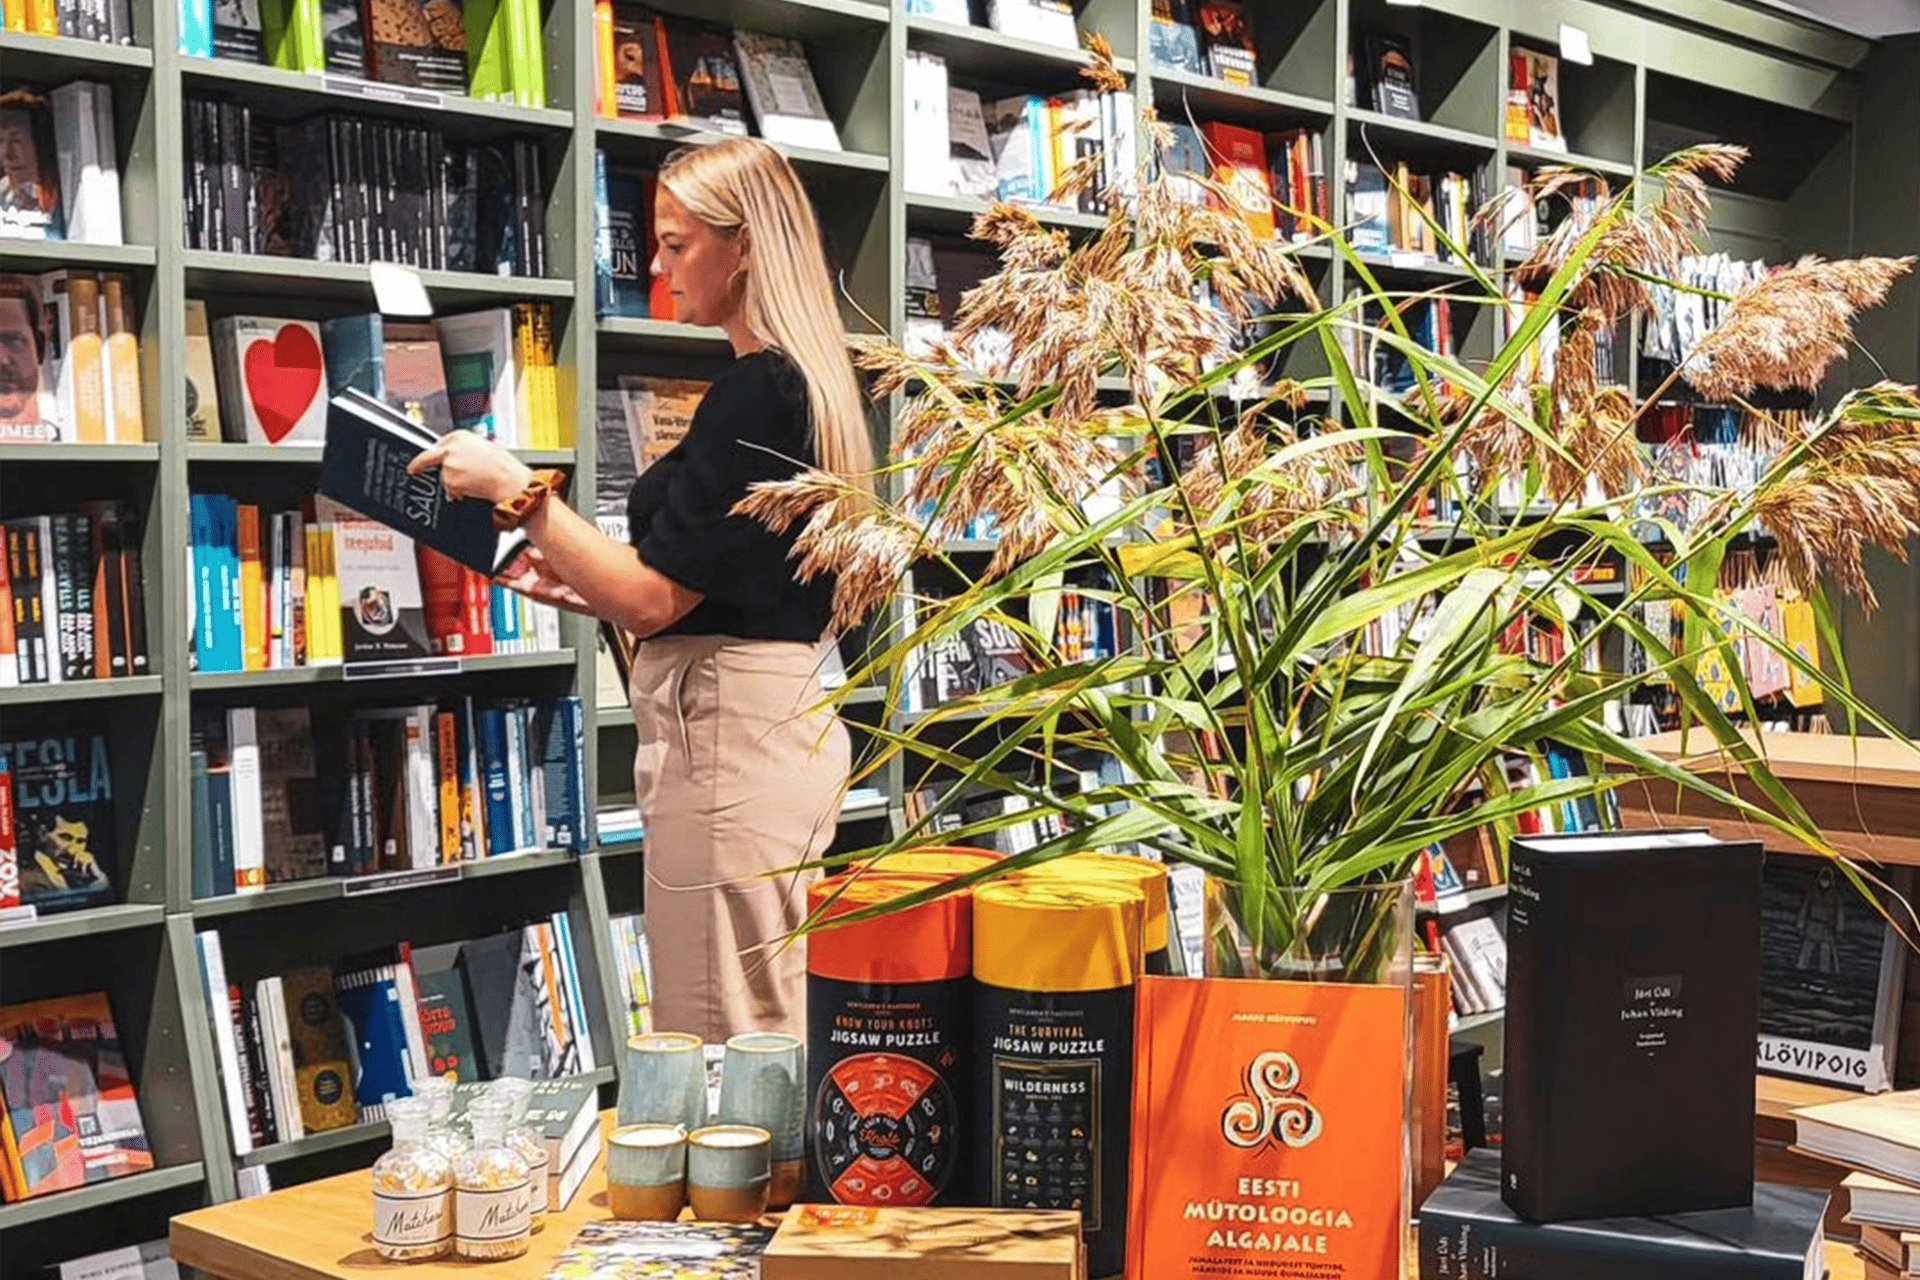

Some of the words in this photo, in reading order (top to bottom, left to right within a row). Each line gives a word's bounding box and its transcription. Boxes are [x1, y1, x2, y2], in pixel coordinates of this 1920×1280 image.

[836, 1015, 863, 1028] KNOW
[867, 1018, 895, 1031] YOUR
[899, 1017, 934, 1031] KNOTS
[1009, 1024, 1026, 1037] THE
[1031, 1026, 1085, 1039] SURVIVAL
[830, 1029, 881, 1046] JIGSAW
[885, 1031, 941, 1047] PUZZLE
[993, 1036, 1044, 1053] JIGSAW
[1049, 1039, 1105, 1055] PUZZLE
[1003, 1079, 1086, 1094] WILDERNESS
[1238, 1177, 1300, 1199] EESTI
[1183, 1198, 1353, 1229] MÜTOLOOGIA
[1206, 1229, 1328, 1255] ALGAJALE
